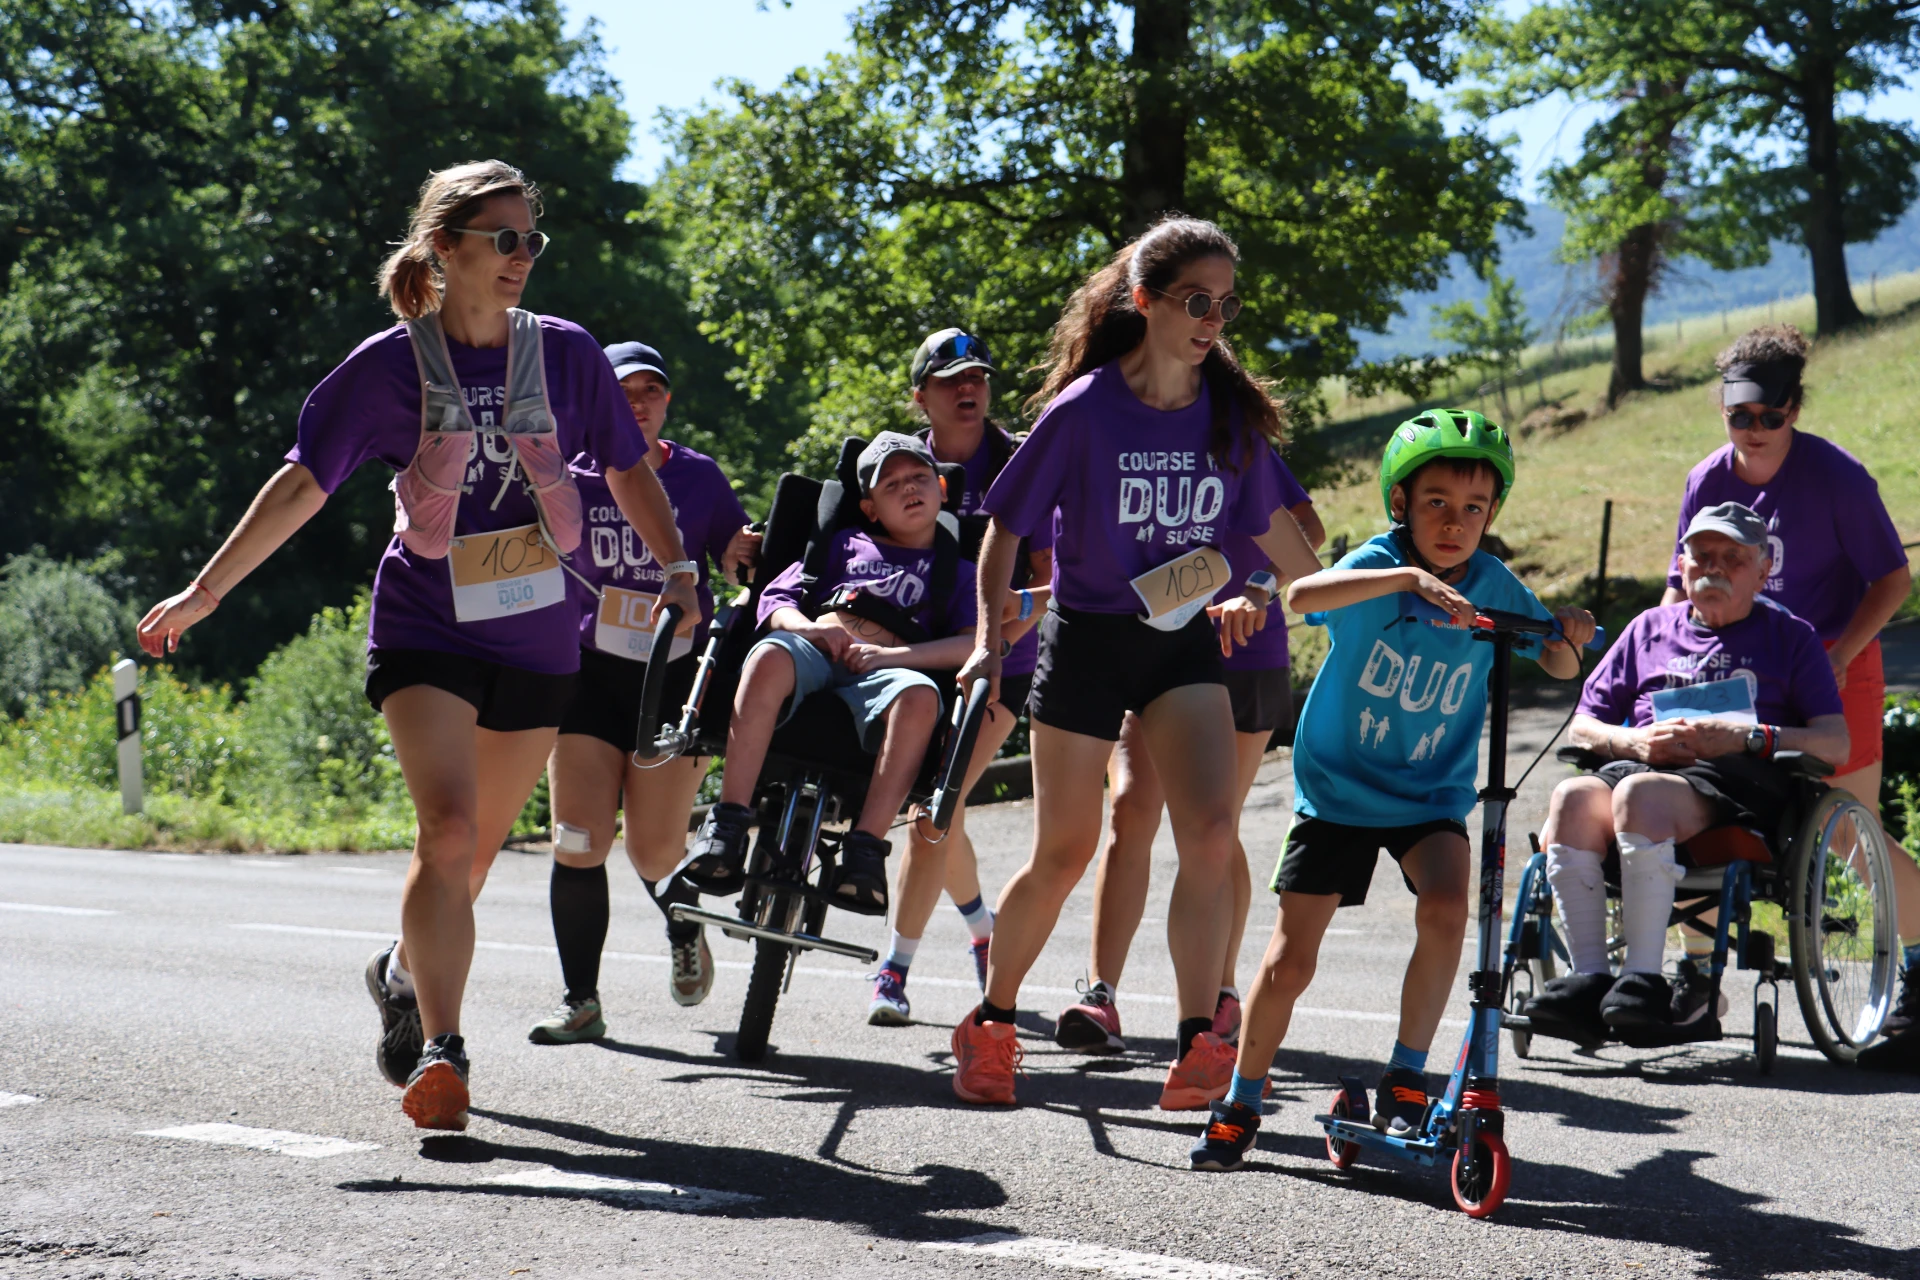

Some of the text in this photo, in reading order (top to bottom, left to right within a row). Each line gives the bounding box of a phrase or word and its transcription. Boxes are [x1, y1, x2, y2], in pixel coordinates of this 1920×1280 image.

[1118, 451, 1196, 471] COURSE
[1118, 476, 1225, 527] DUO
[589, 506, 626, 522] COU
[481, 529, 545, 576] 109
[632, 567, 665, 582] SUIS
[846, 560, 905, 576] COURS
[1166, 556, 1214, 603] 109
[498, 584, 534, 605] DUO
[618, 594, 655, 629] 10
[628, 637, 653, 652] DU
[1358, 639, 1472, 715] DUO
